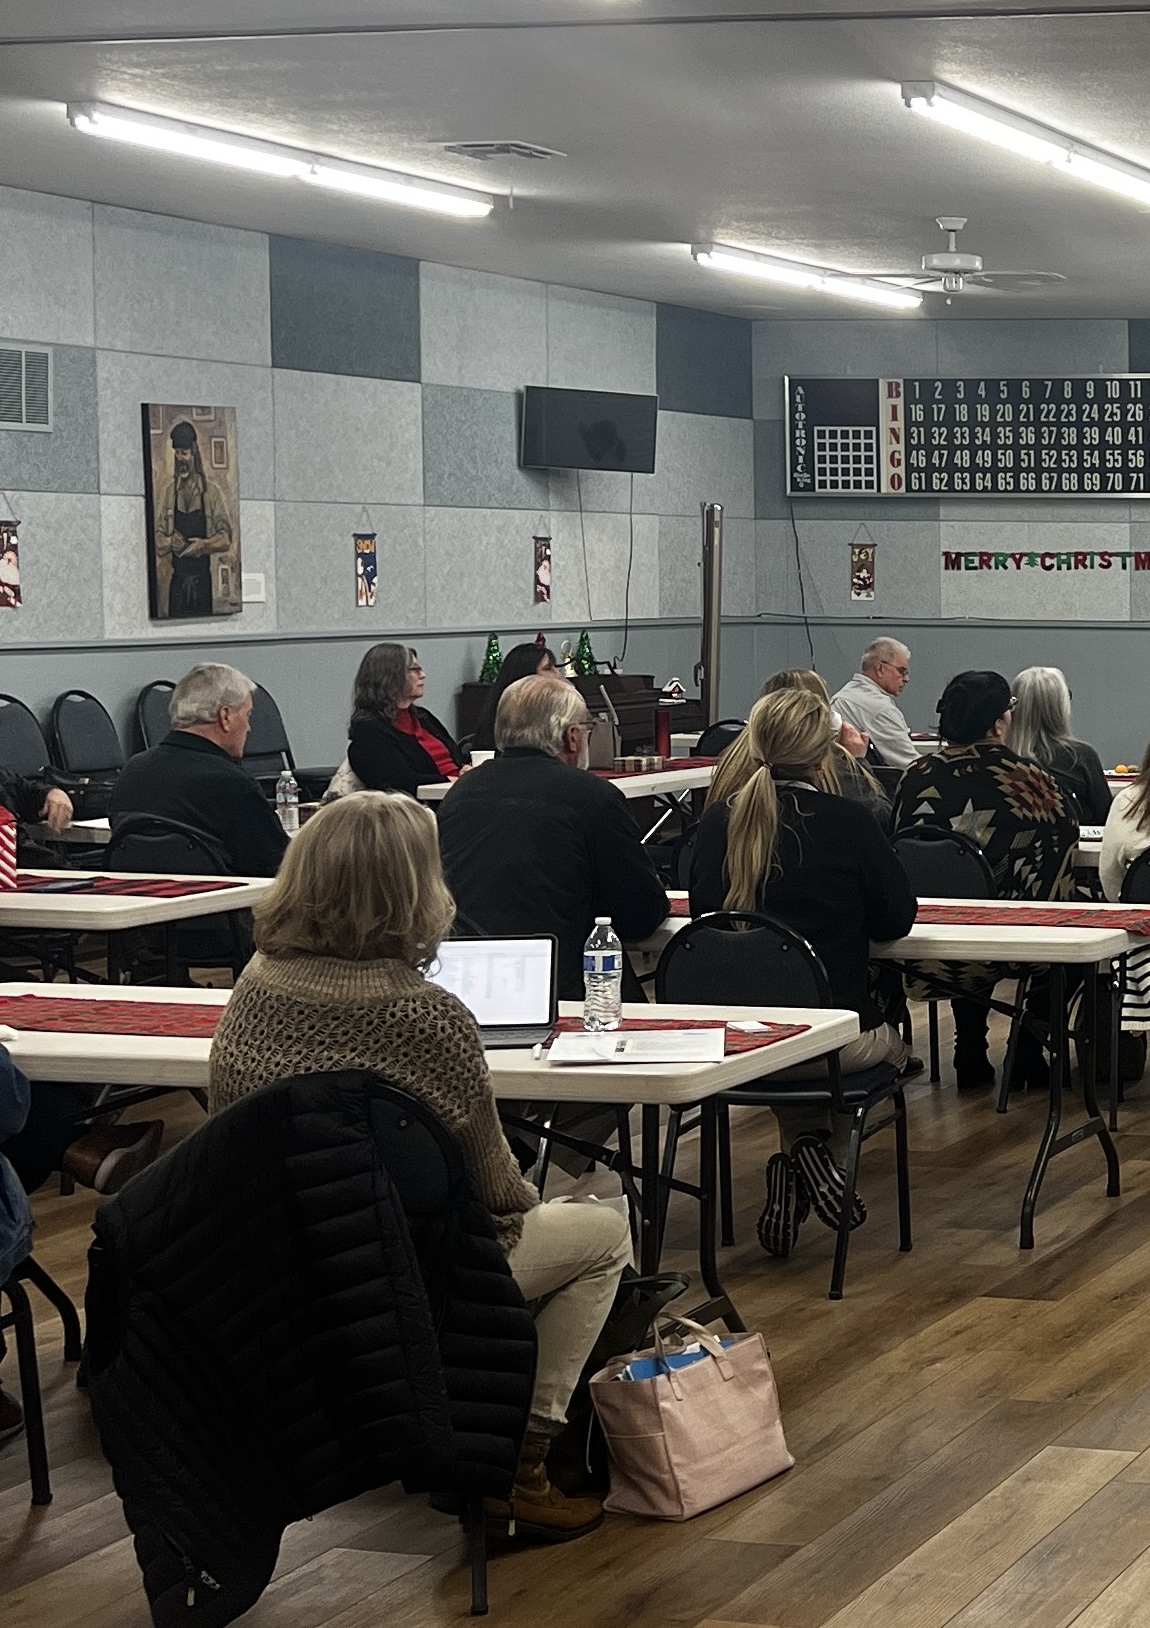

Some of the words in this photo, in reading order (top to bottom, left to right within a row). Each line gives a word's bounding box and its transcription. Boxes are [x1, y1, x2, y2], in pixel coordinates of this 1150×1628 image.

[913, 381, 920, 399] 1
[934, 381, 943, 399] 2
[956, 380, 965, 399] 3
[977, 381, 986, 399] 4
[999, 380, 1008, 399] 5
[1022, 380, 1030, 399] 6
[1044, 380, 1052, 399] 7
[1063, 380, 1072, 399] 8
[1086, 380, 1095, 399] 9
[1105, 380, 1120, 399] 10
[1128, 380, 1142, 399] 11
[909, 403, 924, 422] 16
[931, 403, 946, 422] 17
[953, 403, 968, 422] 18
[975, 403, 990, 422] 19
[996, 403, 1013, 422] 20
[1019, 403, 1034, 422] 21
[1040, 403, 1057, 422] 22
[1060, 403, 1077, 422] 23
[1081, 403, 1099, 422] 24
[1104, 403, 1121, 422] 25
[1126, 403, 1144, 422] 26
[886, 381, 903, 491] BINGO
[910, 426, 925, 445] 31
[931, 426, 948, 445] 32
[953, 426, 970, 445] 33
[974, 426, 991, 445] 34
[996, 426, 1013, 445] 35
[1018, 426, 1036, 445] 36
[1040, 426, 1057, 445] 37
[1061, 426, 1077, 446] 38
[1082, 426, 1100, 445] 39
[1104, 426, 1122, 445] 40
[1127, 426, 1143, 445] 41
[909, 449, 927, 468] 46
[931, 449, 948, 468] 47
[953, 449, 971, 468] 48
[975, 449, 992, 468] 49
[997, 449, 1014, 468] 50
[1020, 449, 1035, 468] 51
[1041, 449, 1058, 468] 52
[1061, 449, 1078, 469] 53
[1083, 449, 1100, 468] 54
[1105, 449, 1122, 468] 55
[1128, 449, 1145, 468] 56
[911, 472, 926, 491] 61
[932, 472, 949, 491] 62
[953, 472, 971, 491] 63
[975, 472, 992, 491] 64
[997, 472, 1014, 491] 65
[1019, 472, 1036, 491] 66
[1041, 472, 1058, 491] 67
[1061, 472, 1079, 491] 68
[1083, 472, 1101, 491] 69
[1105, 472, 1123, 491] 70
[1129, 472, 1144, 491] 71
[852, 548, 874, 562] JOY
[943, 552, 1023, 571] MERRY
